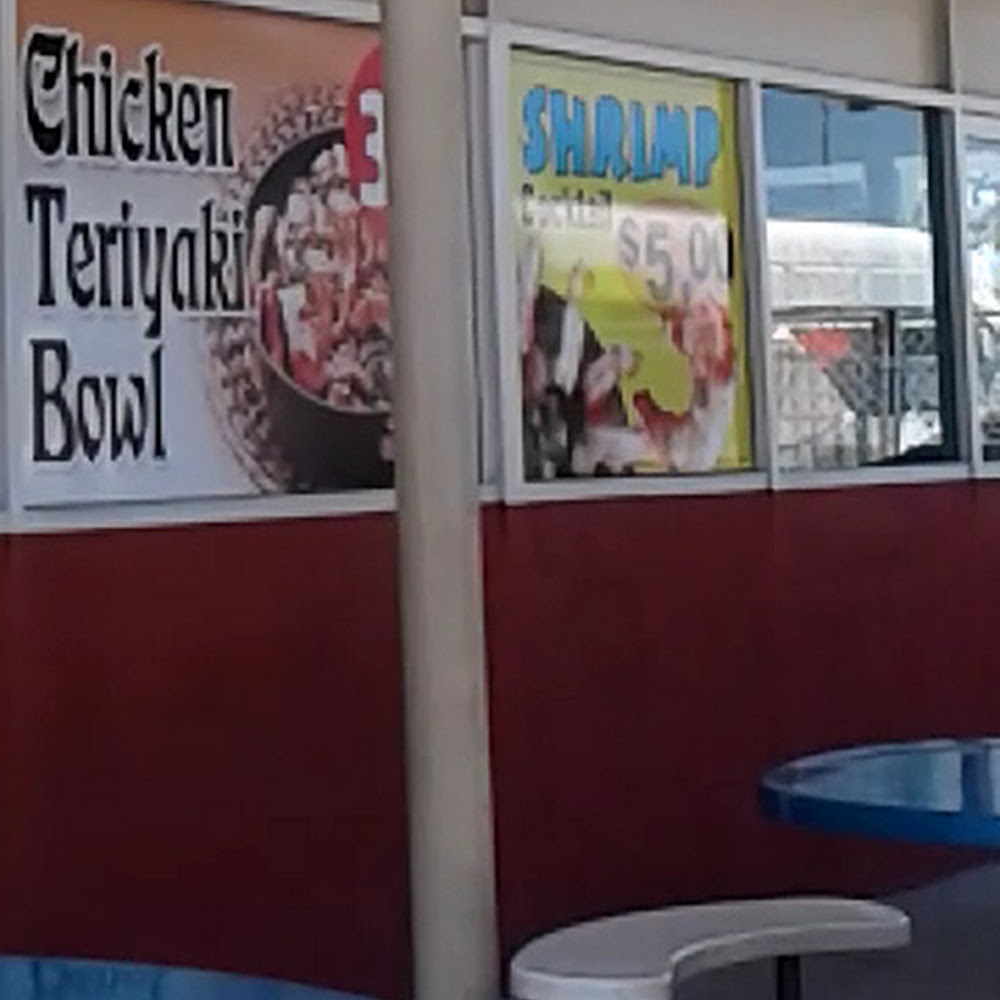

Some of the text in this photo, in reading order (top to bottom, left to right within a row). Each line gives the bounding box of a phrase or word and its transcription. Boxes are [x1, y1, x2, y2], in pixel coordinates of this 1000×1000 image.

[26, 32, 234, 167] Chicken
[522, 85, 722, 188] SHRIMP
[25, 184, 246, 338] Teriyaki
[30, 339, 167, 463] Bowl
